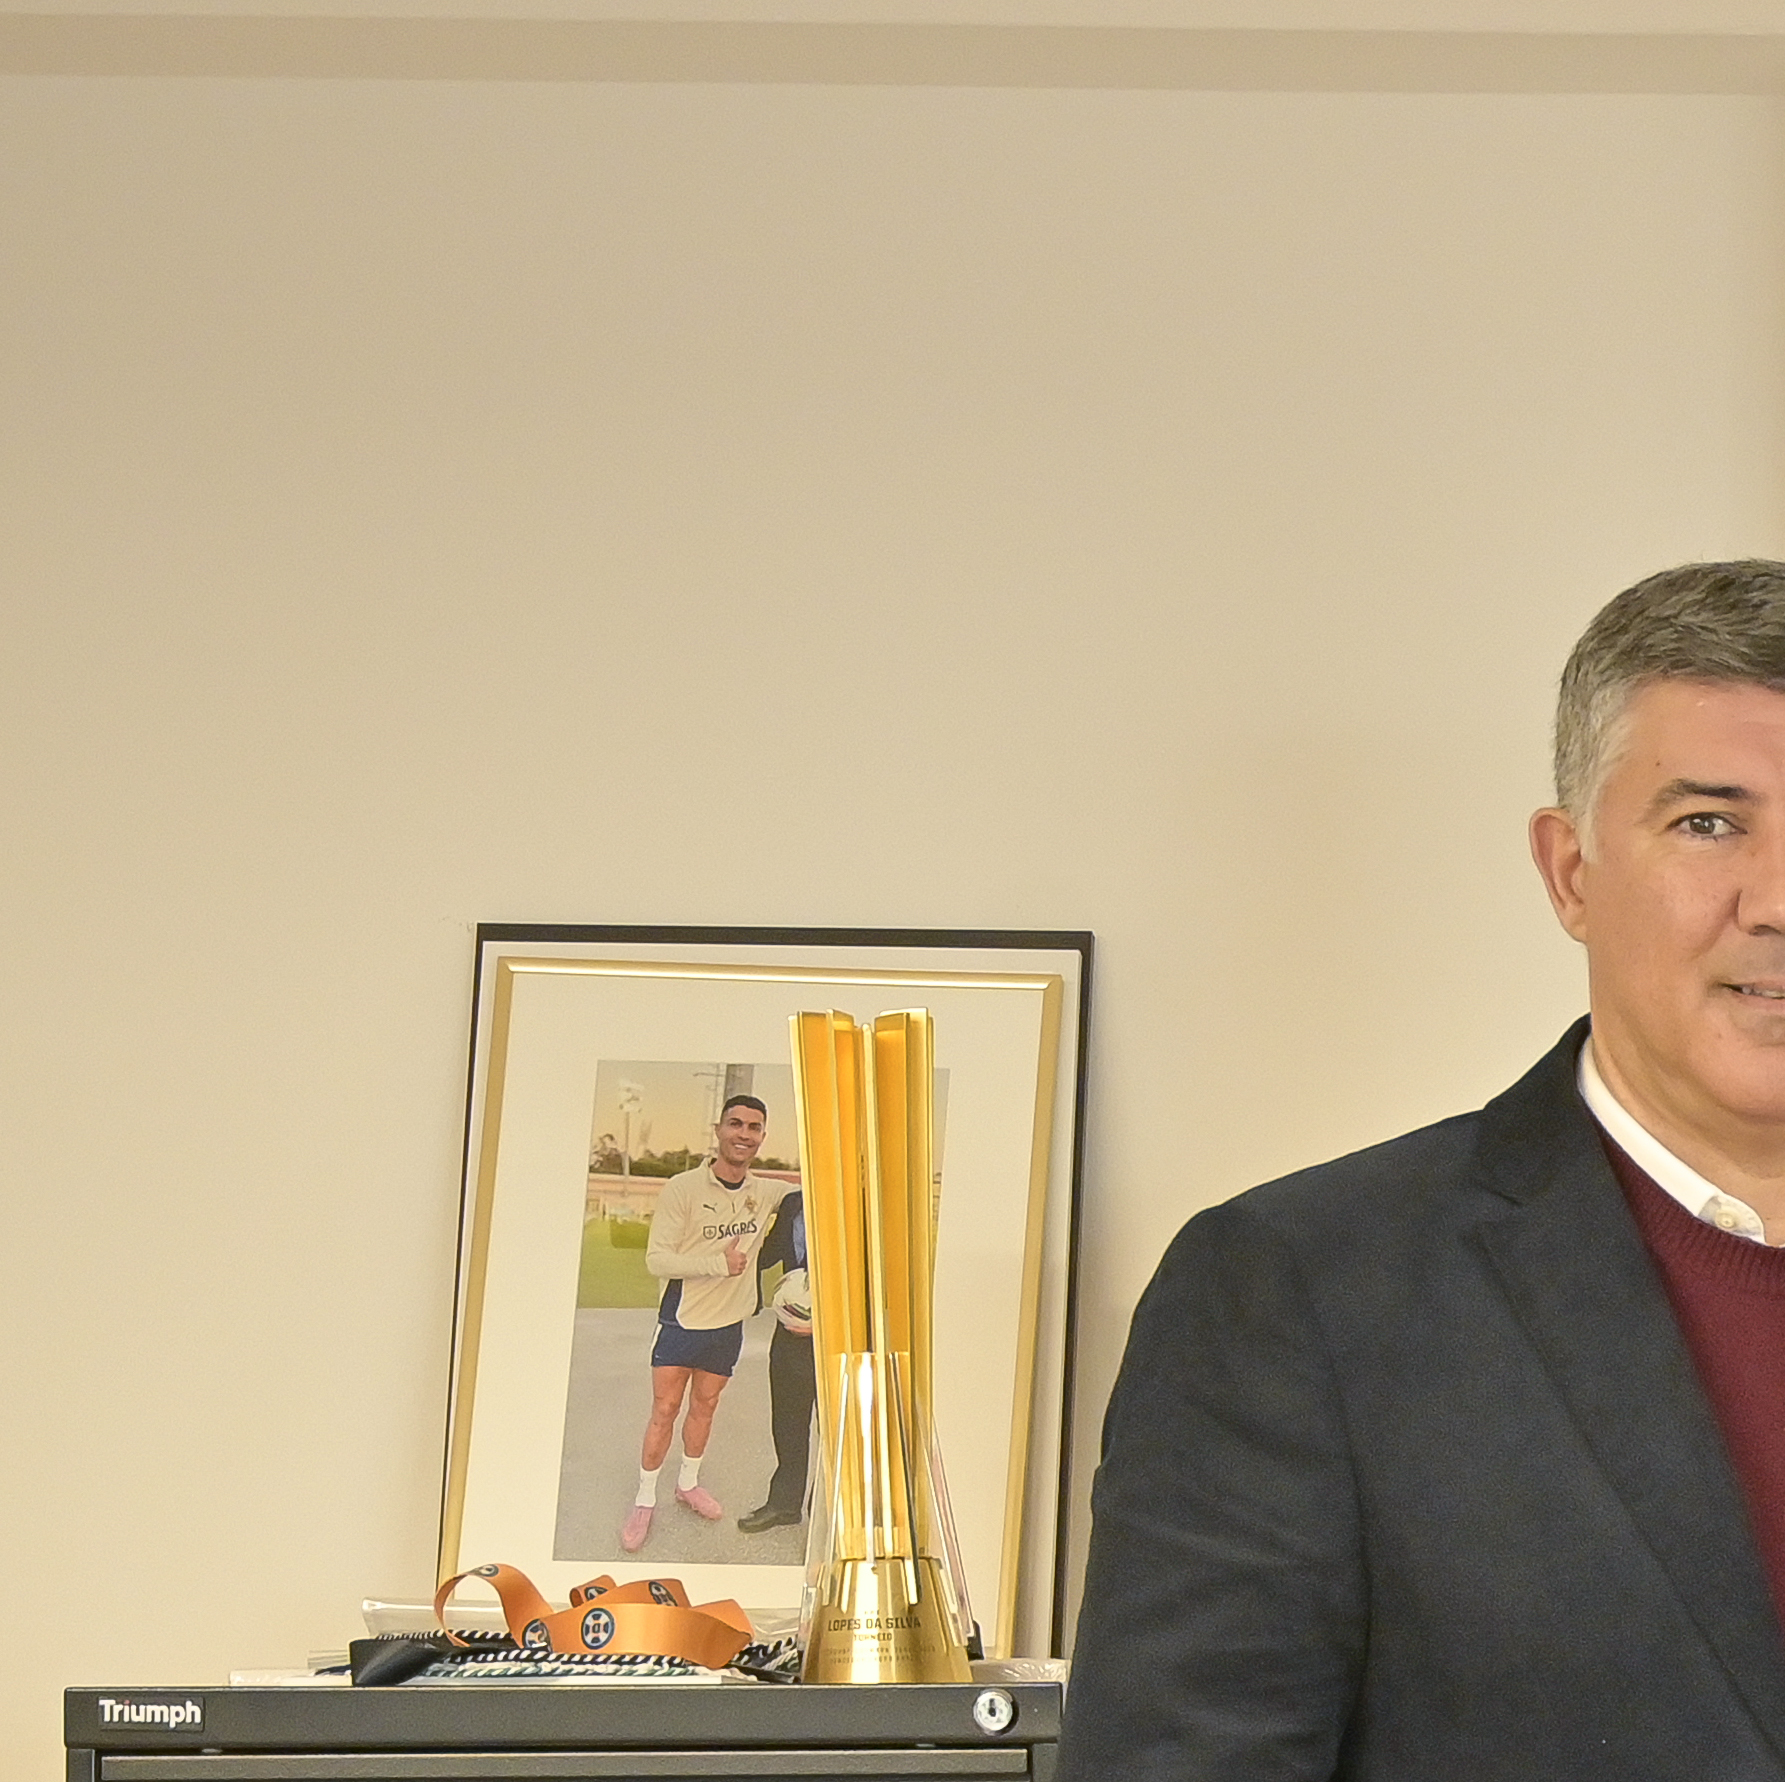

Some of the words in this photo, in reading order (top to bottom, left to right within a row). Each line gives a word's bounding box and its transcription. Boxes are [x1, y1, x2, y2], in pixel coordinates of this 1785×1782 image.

[827, 1618, 861, 1632] LOPES
[865, 1617, 882, 1629] DA
[885, 1616, 922, 1629] SILVA
[98, 1699, 202, 1728] Triumph
